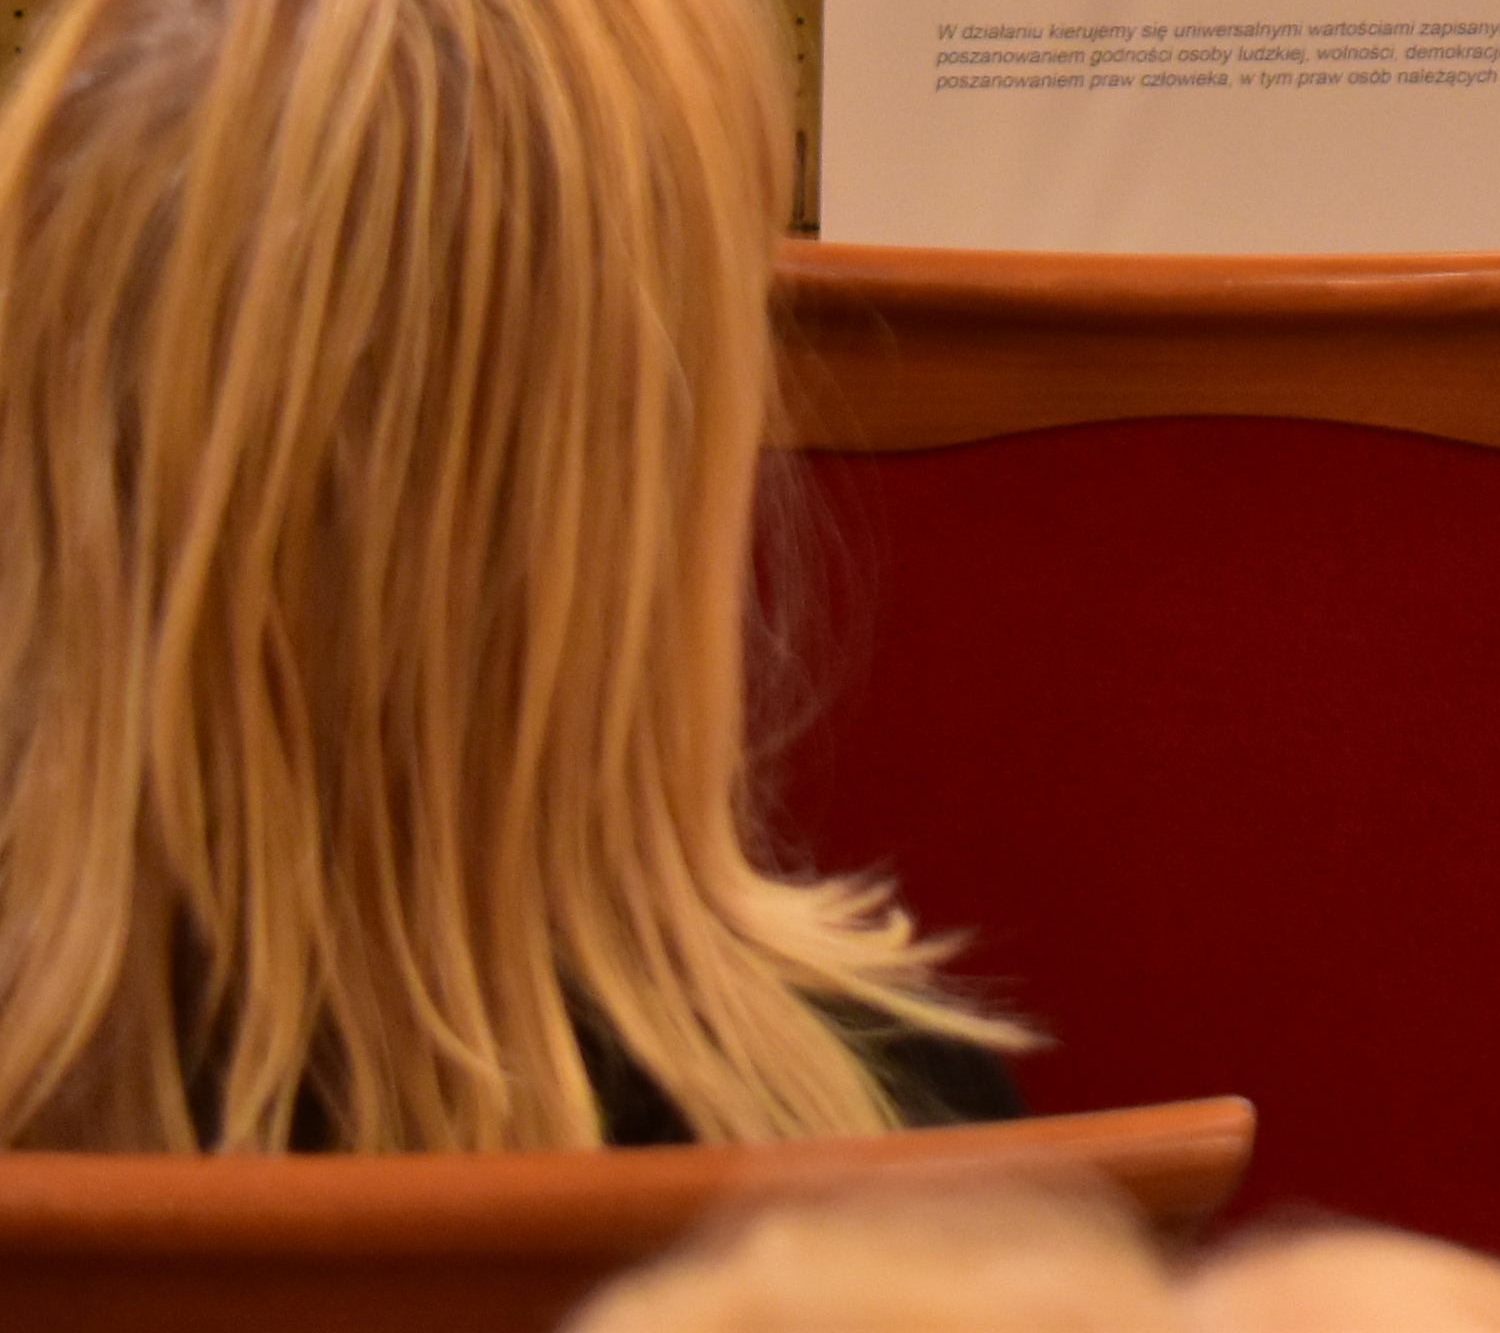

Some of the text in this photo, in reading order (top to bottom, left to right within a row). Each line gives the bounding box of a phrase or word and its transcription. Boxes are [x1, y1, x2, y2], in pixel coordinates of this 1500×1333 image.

[938, 24, 958, 39] W
[962, 23, 1043, 39] działaniu
[1049, 23, 1137, 42] kierujemy
[1141, 23, 1168, 41] się
[1174, 21, 1304, 41] uniwersalnymi
[1308, 19, 1414, 36] wartościami
[936, 51, 1085, 66] poszanowaniem
[1090, 45, 1173, 66] godności
[1177, 45, 1232, 65] osoby
[936, 75, 1083, 90] poszanowaniem
[1090, 75, 1135, 90] praw
[1240, 74, 1258, 86] w
[1260, 71, 1292, 89] tym
[1297, 71, 1341, 88] praw
[1348, 68, 1392, 85] osób
[1397, 67, 1498, 87] należących
